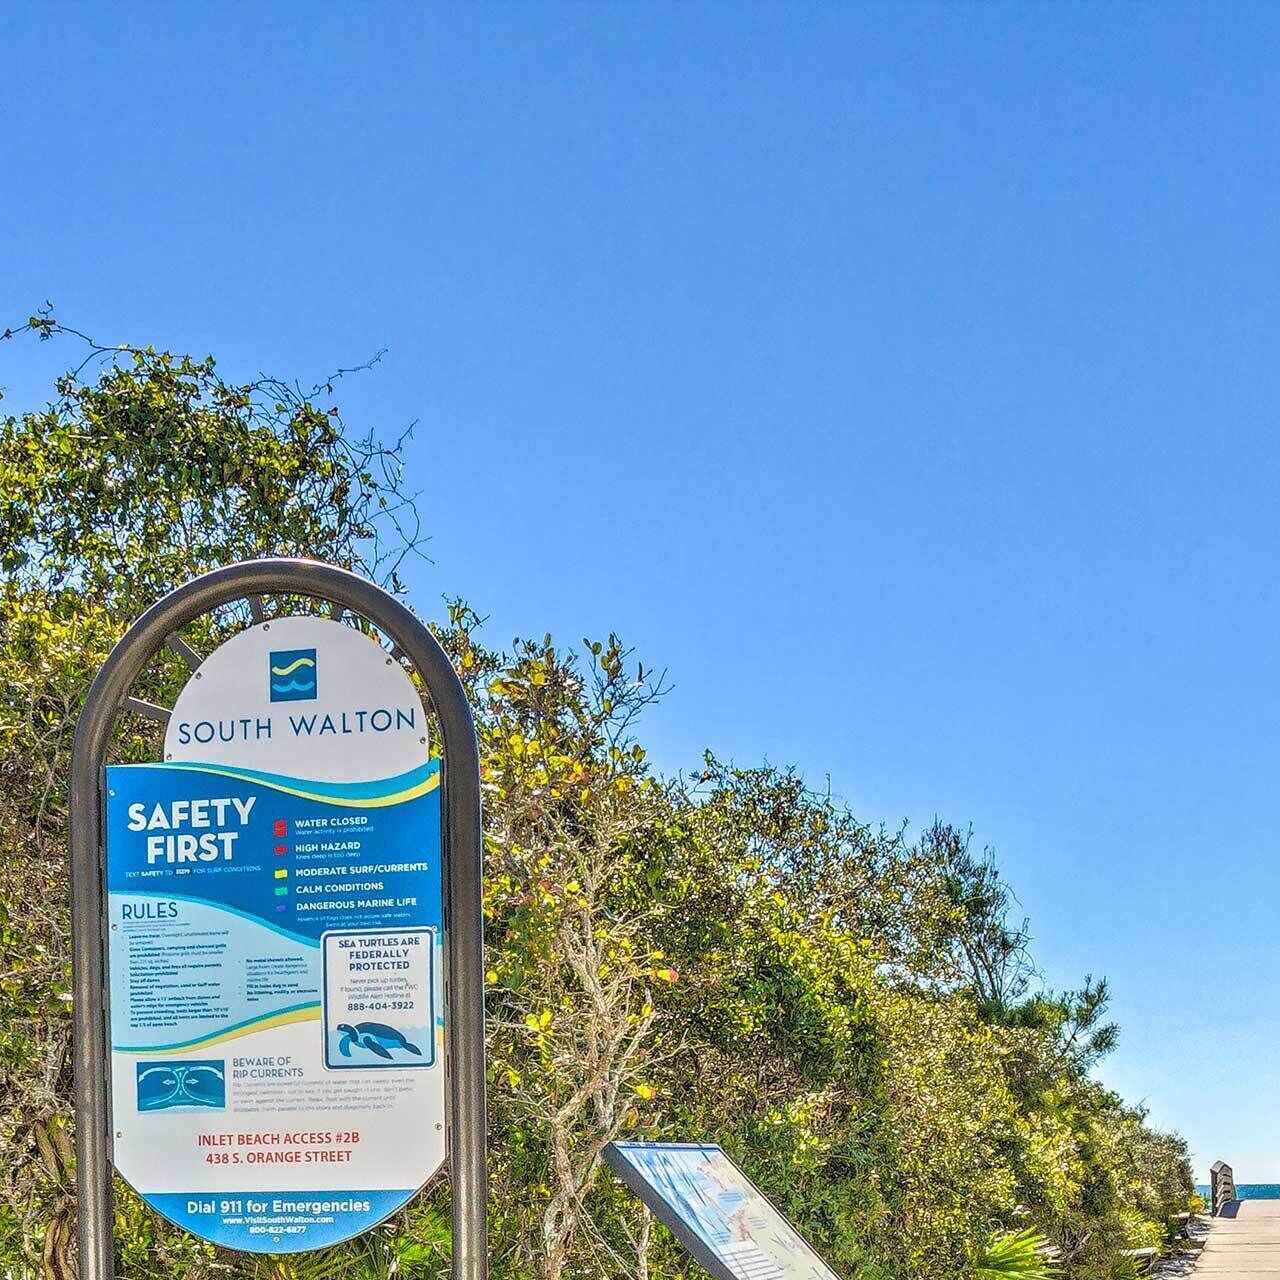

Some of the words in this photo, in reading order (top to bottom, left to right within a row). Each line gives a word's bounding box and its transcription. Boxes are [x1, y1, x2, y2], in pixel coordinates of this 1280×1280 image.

[178, 718, 271, 745] SOUTH
[289, 708, 416, 737] WALTON
[127, 796, 257, 832] SAFETY
[295, 818, 328, 828] WATER
[330, 816, 368, 827] CLOSED
[147, 832, 239, 864] FIRST
[295, 844, 319, 853] HIGH
[320, 842, 361, 851] HAZARD
[295, 866, 347, 877] MODERATE
[350, 862, 429, 875] SURF/CURRENTS
[296, 884, 323, 894] CALM
[324, 882, 384, 892] CONDITIONS
[296, 900, 355, 911] DANGEROUS
[357, 898, 394, 908] MARINE
[396, 897, 417, 907] LIFE
[122, 902, 178, 920] RULES
[338, 939, 356, 949] SEA
[359, 938, 399, 948] TURTLES
[400, 937, 420, 946] ARE
[349, 949, 409, 960] FEDERALLY
[349, 961, 410, 971] PROTECTED
[347, 1001, 414, 1011] 888-404-3922
[232, 1057, 275, 1067] BEWARE
[277, 1056, 291, 1066] OF
[232, 1069, 249, 1079] RIP
[250, 1067, 304, 1078] CURRENTS
[198, 1134, 234, 1147] INLET
[237, 1133, 281, 1146] BEACH
[283, 1132, 333, 1145] ACCESS
[335, 1131, 360, 1144] #2B
[205, 1152, 230, 1165] 438
[232, 1152, 244, 1164] S.
[246, 1151, 302, 1164] ORANGE
[304, 1150, 353, 1163] STREET
[187, 1200, 216, 1214] Dial
[219, 1200, 242, 1214] 911
[246, 1199, 269, 1213] for
[272, 1198, 371, 1216] Emergencies
[222, 1215, 334, 1225] www.VisitSouthWalton.com
[249, 1225, 307, 1235] 800-822-6877
